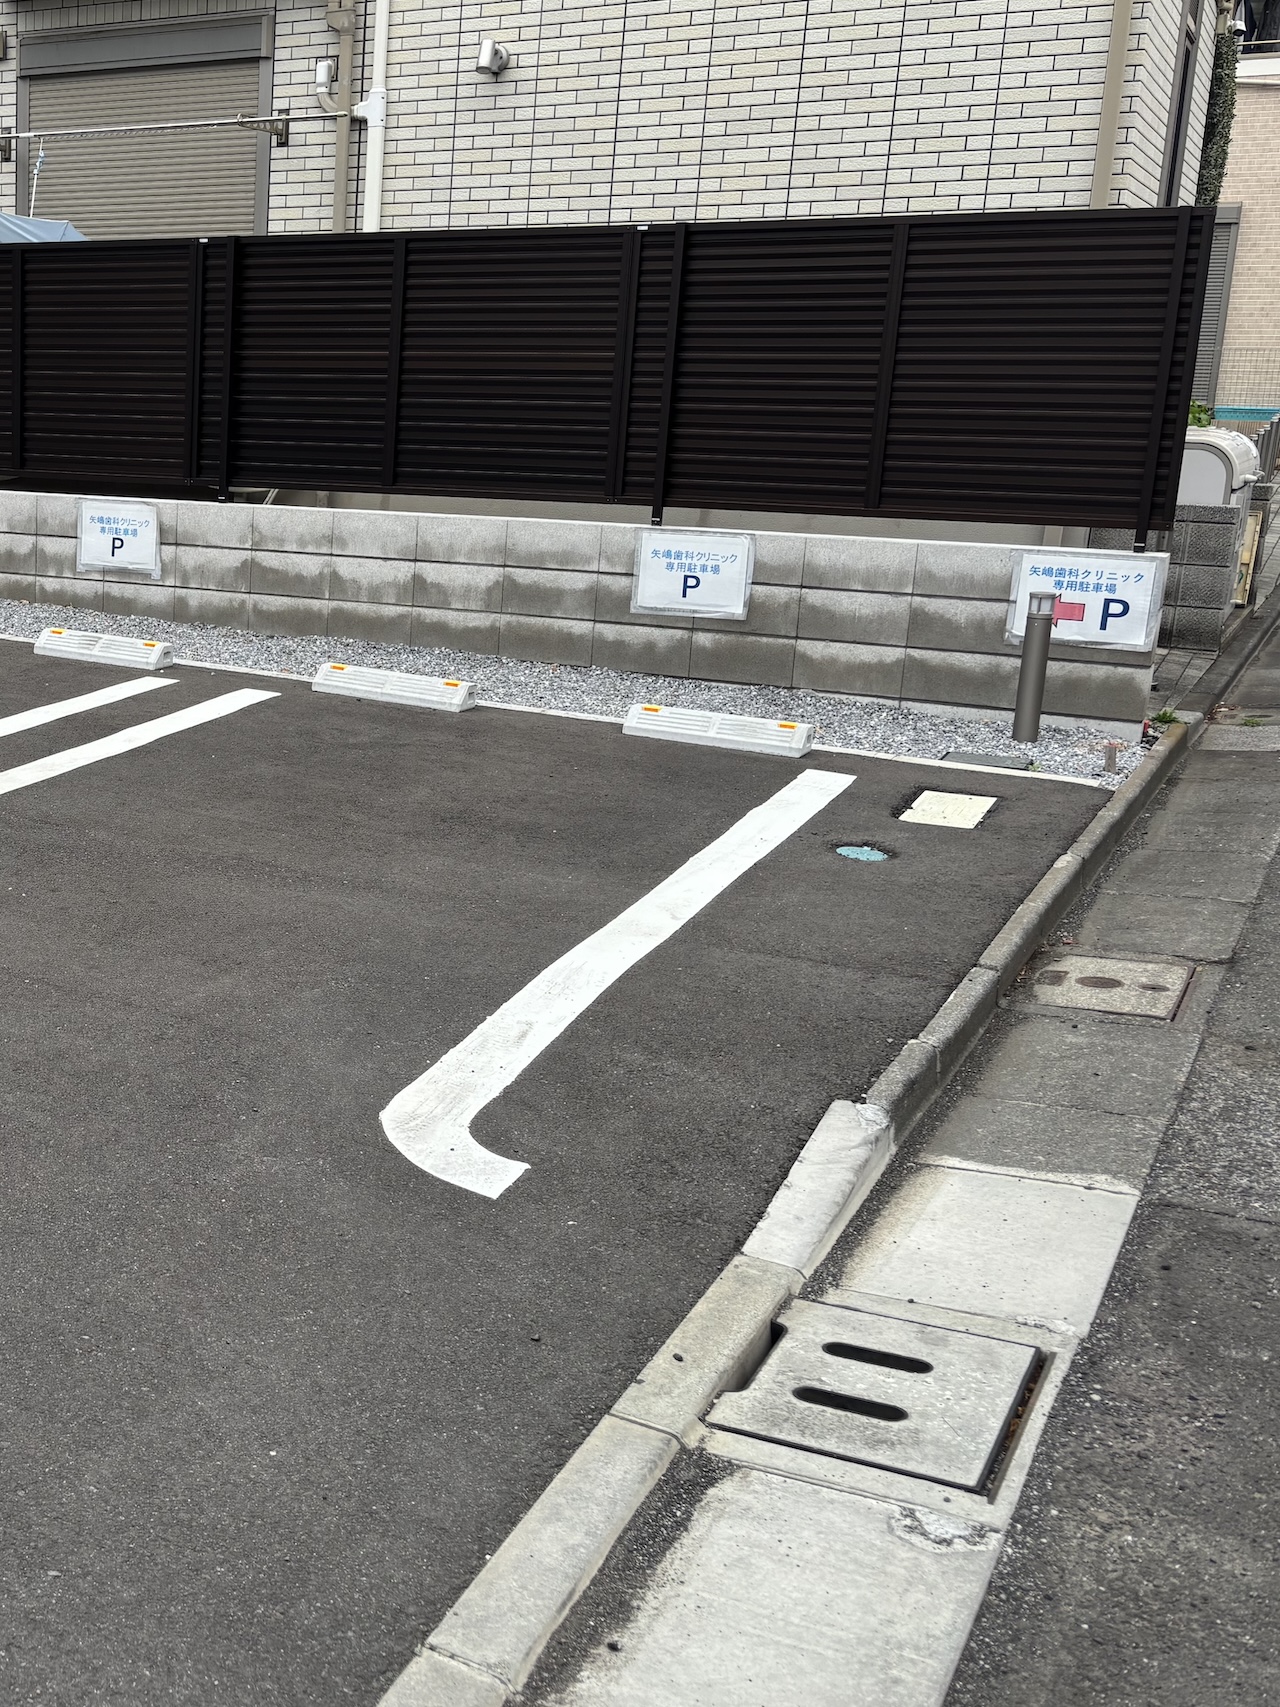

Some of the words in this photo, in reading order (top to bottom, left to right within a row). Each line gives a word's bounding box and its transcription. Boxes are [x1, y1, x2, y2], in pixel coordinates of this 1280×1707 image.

[111, 537, 124, 557] P
[650, 548, 738, 564] 矢嶋歯科クリニック
[665, 561, 721, 575] 専用駐車場
[1028, 565, 1145, 584] 矢嶋歯科クリニック
[681, 574, 701, 598] P
[1052, 579, 1117, 595] 専用駐車場
[1099, 597, 1130, 631] P
